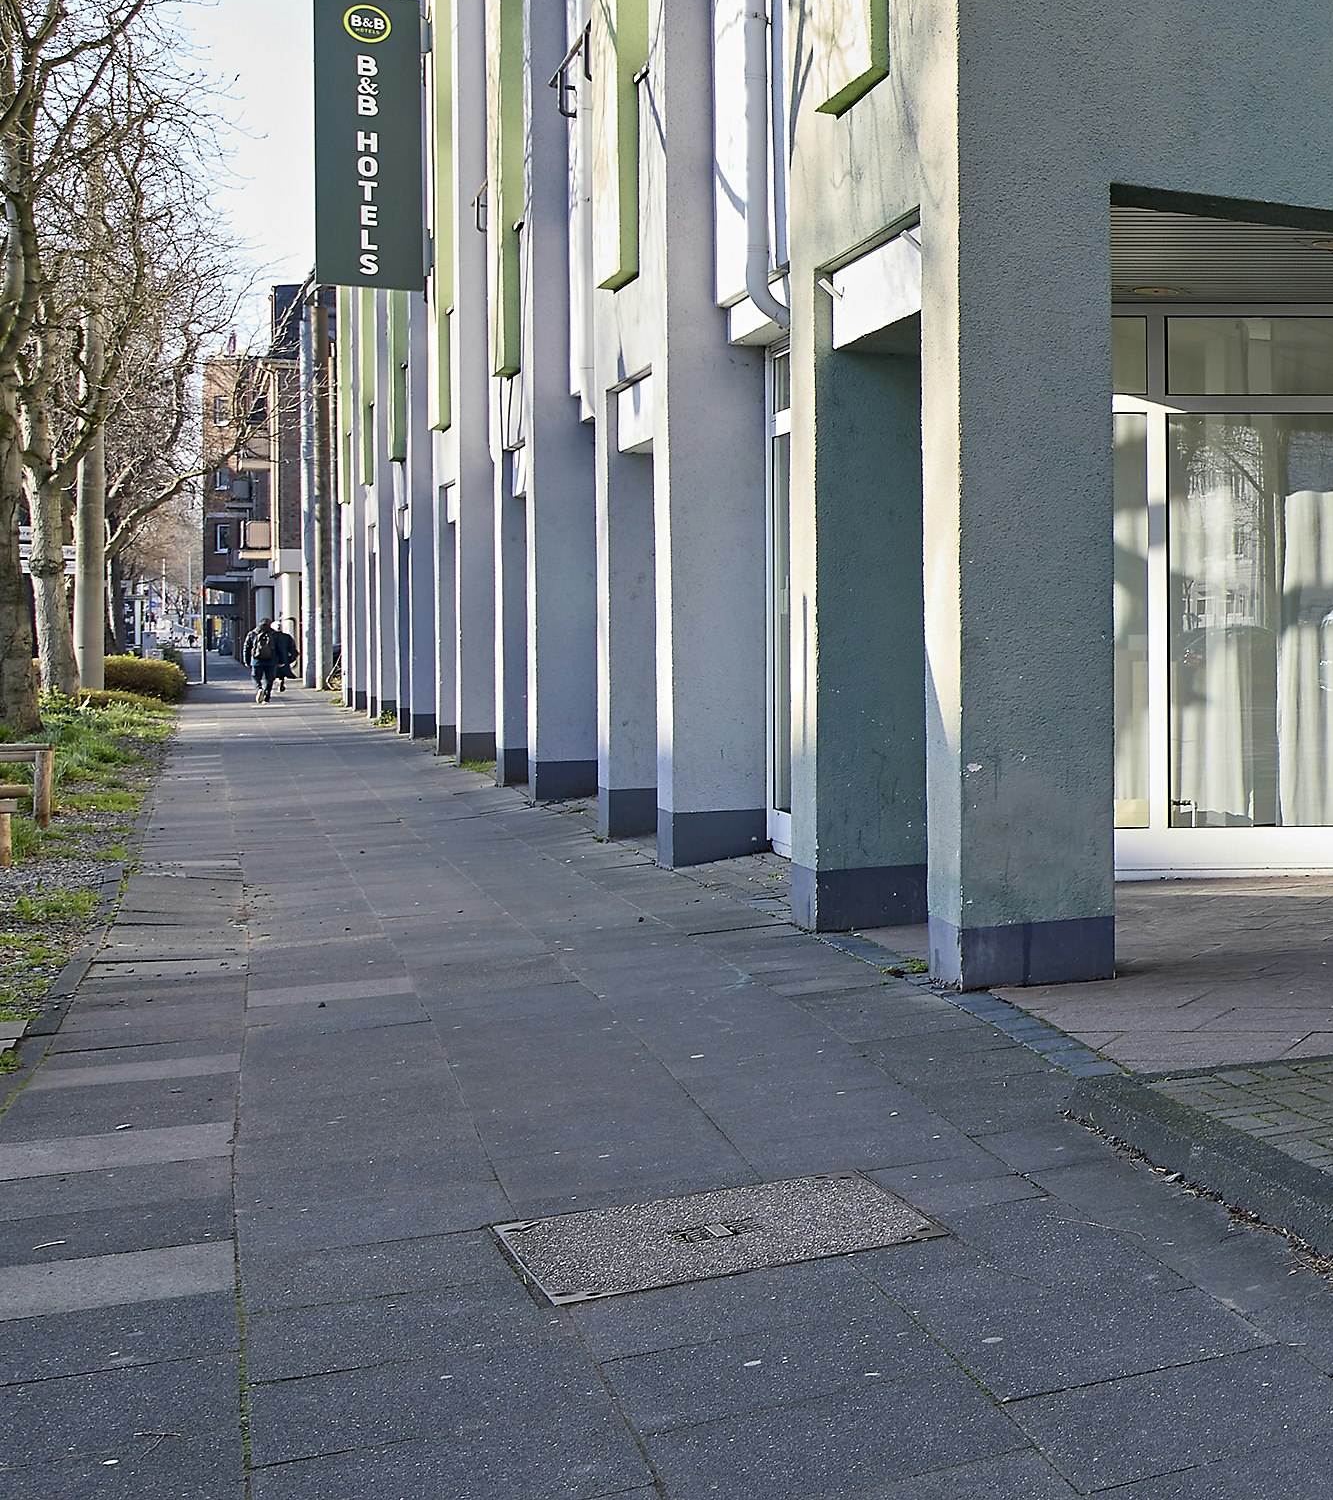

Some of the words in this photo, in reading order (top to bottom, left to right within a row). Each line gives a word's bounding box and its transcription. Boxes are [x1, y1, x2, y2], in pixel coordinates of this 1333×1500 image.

[351, 14, 386, 30] B&B
[356, 53, 379, 117] B&B
[357, 131, 380, 276] HOTELS
